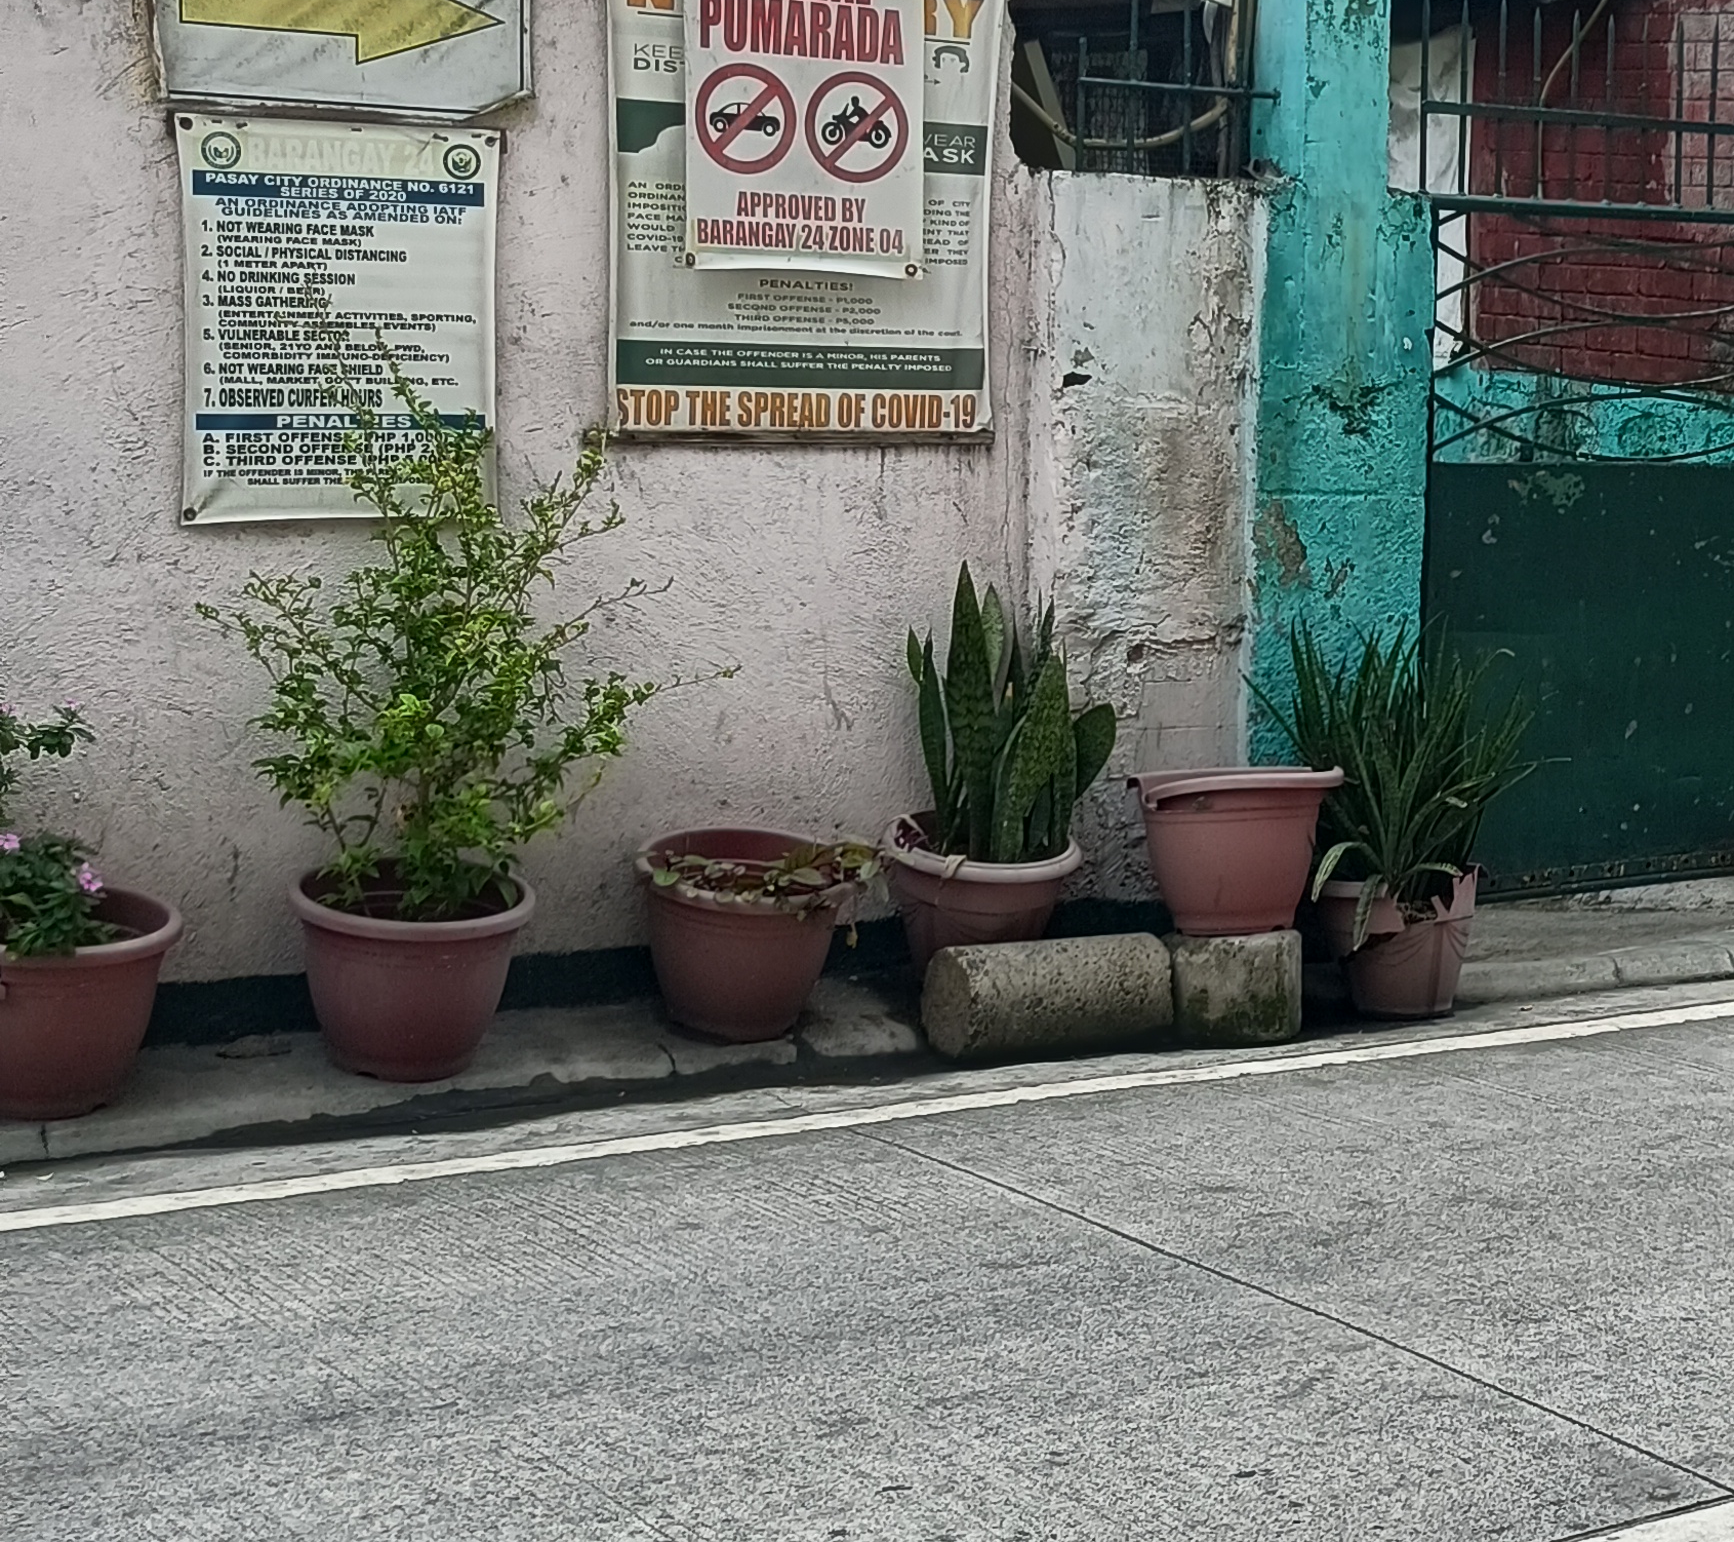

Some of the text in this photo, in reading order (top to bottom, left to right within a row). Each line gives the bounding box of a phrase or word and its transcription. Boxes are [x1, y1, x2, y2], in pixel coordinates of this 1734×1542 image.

[634, 43, 684, 60] KEE
[633, 57, 685, 73] DIS
[248, 137, 396, 176] BARANGAY
[403, 143, 435, 177] 24
[924, 147, 975, 164] ASK
[205, 172, 474, 195] PASAY CITY ORDINANCE NO. 6121
[280, 186, 407, 202] SERIES OF 2020
[215, 197, 467, 217] AN ORDINANCE ADOPTING IATF
[737, 191, 866, 223] APPROVED BY
[221, 206, 463, 225] GUIDELINES AS AMENDED ON:
[201, 219, 375, 238] 1. NOT WEARING FACE MASK
[627, 222, 675, 232] WOULD
[217, 234, 362, 248] (WEARING FACE MASK)
[626, 233, 684, 243] COVID-19
[697, 218, 904, 254] BARANGAY 24 ZONE 04
[200, 244, 407, 263] 2. SOCIAL / PHYSICAL DISTANCING
[217, 259, 229, 269] (1
[233, 260, 278, 269] METER
[201, 269, 356, 285] 4. NO DRINKING SESSION
[759, 278, 853, 291] PENALTIES!
[202, 294, 214, 307] 3.
[217, 295, 252, 307] MASS
[737, 292, 770, 301] FIRST
[773, 294, 826, 303] OFFENSE
[727, 302, 777, 311] SECOND
[779, 304, 832, 314] OFFENSE
[411, 313, 477, 324] SPORTING,
[734, 313, 770, 322] THIRD
[773, 314, 826, 324] OFFENSE
[203, 328, 215, 340] 5.
[217, 328, 300, 341] VULNERABLE
[218, 342, 276, 352] (SENIOR,
[279, 342, 313, 351] 21YO
[223, 351, 313, 360] COMORBIDITY
[676, 348, 707, 356] CASE
[711, 349, 733, 357] THE
[737, 350, 799, 358] OFFENDER
[870, 353, 888, 361] HIS
[890, 354, 941, 362] PARENTS
[203, 362, 216, 375] 6.
[218, 363, 244, 375] NOT
[247, 363, 305, 375] WEARING
[666, 358, 737, 367] GUARDIANS
[740, 360, 778, 368] SHALL
[781, 361, 824, 369] SUFFER
[827, 362, 849, 370] THE
[851, 363, 901, 371] PENALTY
[904, 364, 952, 372] IMPOSED
[219, 376, 263, 386] (MALL,
[203, 387, 216, 408] 7.
[219, 387, 285, 408] OBSERVED
[617, 388, 976, 428] STOP THE SPREAD OF COVID-19
[202, 432, 354, 443] A. FIRST OFFENS
[203, 444, 220, 455] B.
[225, 443, 294, 455] SECOND
[203, 455, 357, 467] C. THIRD OFFENSE
[203, 469, 214, 477] IF
[216, 469, 236, 477] THE
[238, 468, 292, 477] OFFENDER
[247, 477, 280, 485] SHALL
[282, 477, 321, 485] SUFFER
